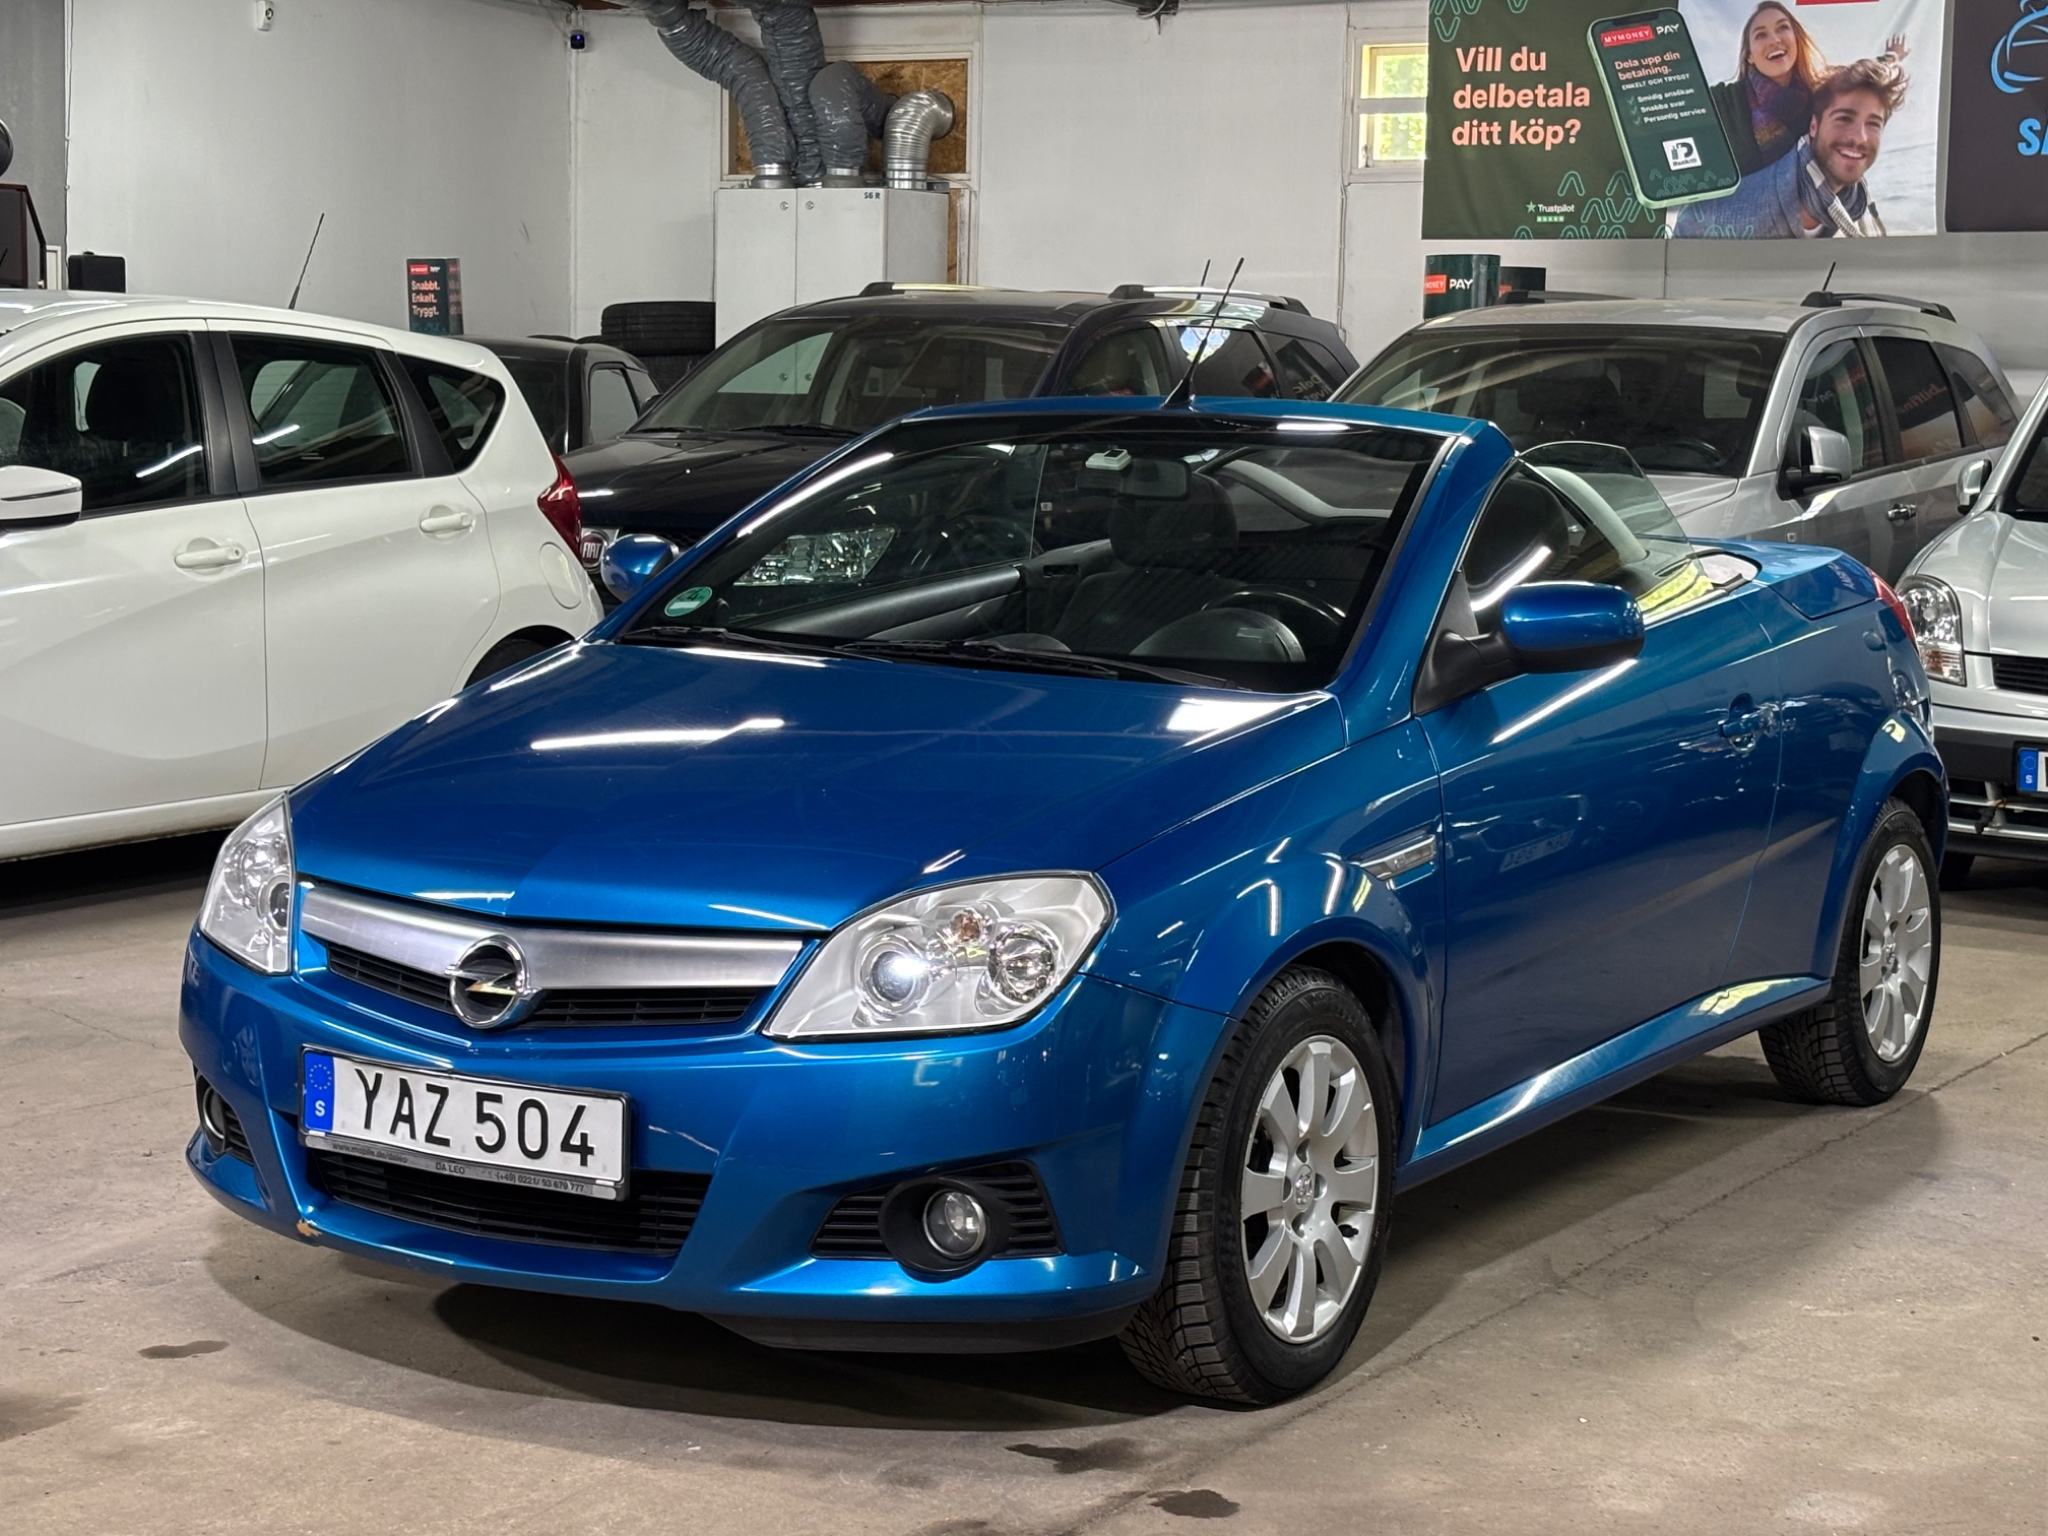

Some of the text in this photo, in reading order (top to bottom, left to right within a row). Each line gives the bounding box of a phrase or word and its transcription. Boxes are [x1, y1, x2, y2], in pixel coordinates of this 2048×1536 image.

[1603, 23, 1680, 43] MYMONEY PAY
[1456, 46, 1547, 72] Vill du
[1614, 51, 1681, 70] Dela upp din
[1617, 65, 1672, 81] betalning.
[1622, 73, 1690, 91] ENKELT OCH TRYGGT
[1453, 82, 1591, 109] delbetala
[1637, 92, 1663, 104] Smidig
[1640, 100, 1686, 113] Snabba svar
[1643, 107, 1707, 124] Personlig service
[1452, 118, 1582, 151] ditt köp?
[1537, 204, 1575, 214] Trustpilot
[411, 280, 441, 291] Snabbt.
[1449, 278, 1474, 290] PAY
[411, 293, 438, 303] Enkelt.
[412, 305, 440, 318] Tryggt.
[582, 541, 602, 559] FIAT
[2025, 774, 2034, 784] S
[315, 1100, 326, 1117] S
[355, 1067, 595, 1168] YAZ 504
